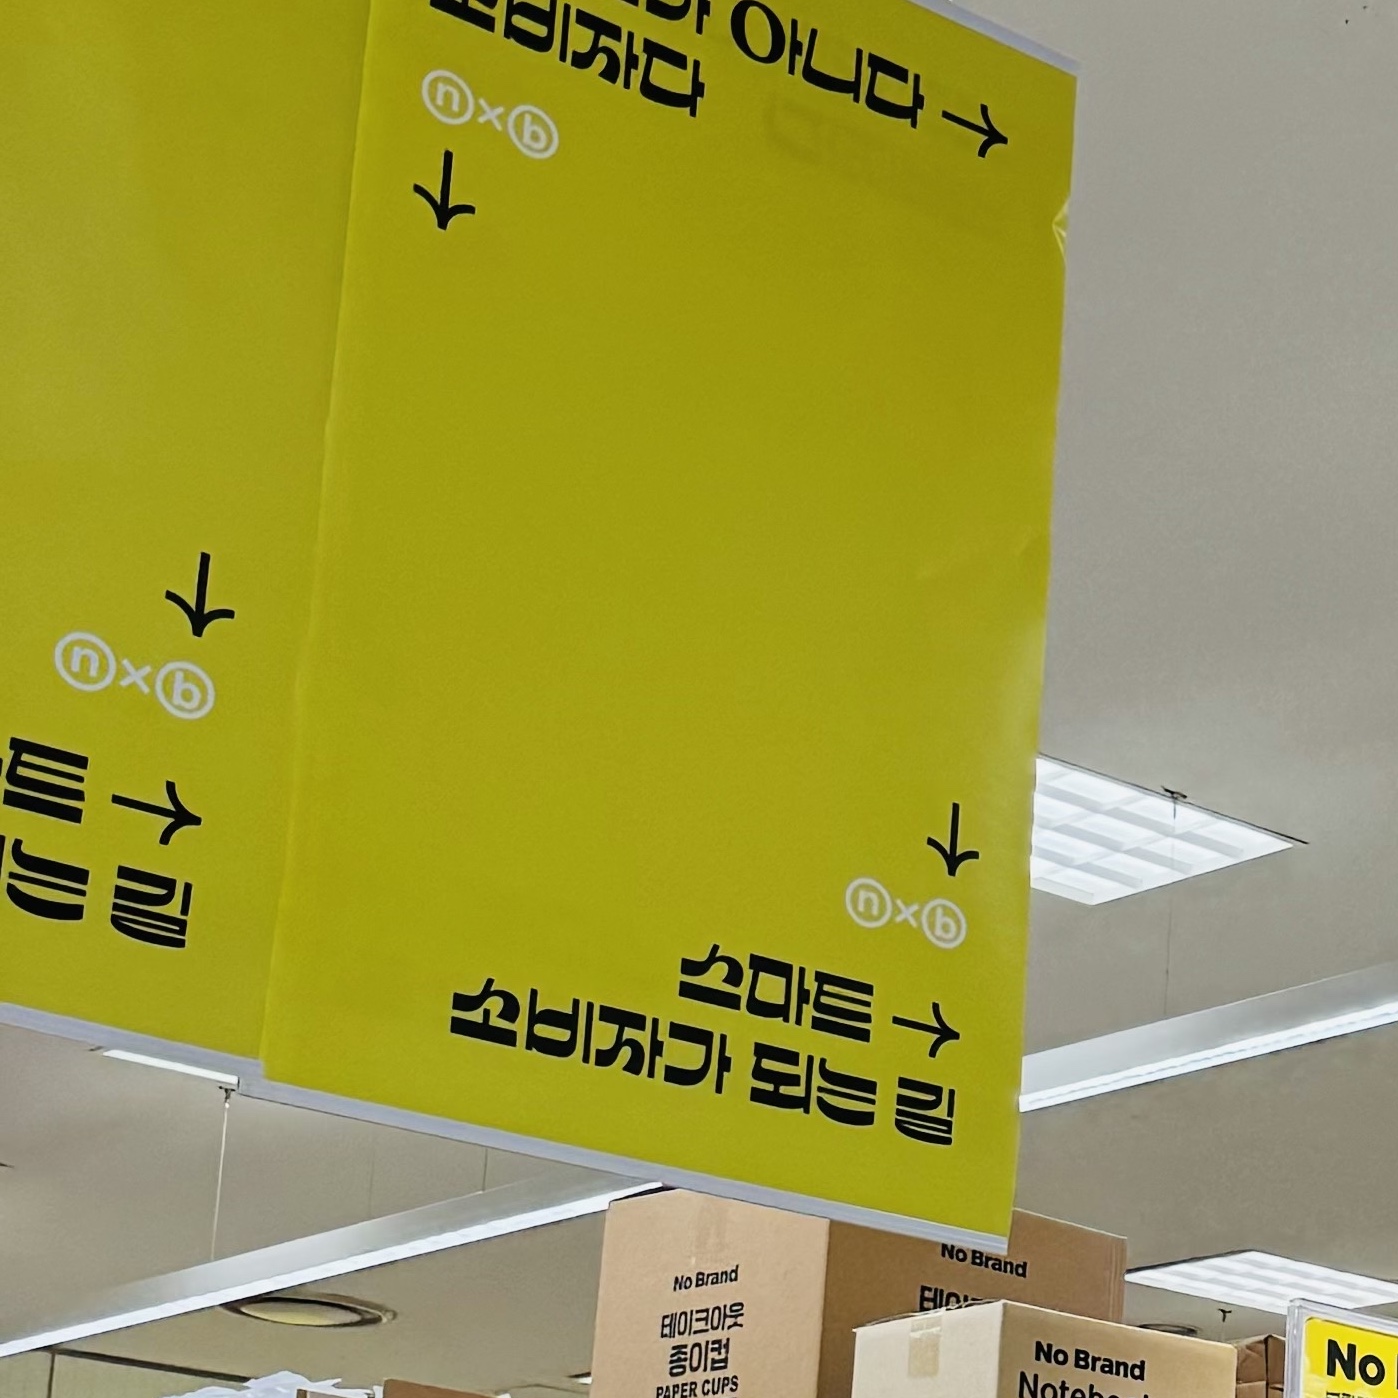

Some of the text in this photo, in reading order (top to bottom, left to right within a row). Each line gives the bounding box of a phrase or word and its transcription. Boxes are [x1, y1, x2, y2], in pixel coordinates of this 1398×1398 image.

[0, 838, 194, 949] 는 길
[679, 943, 876, 1043] 스마트
[451, 977, 957, 1147] 소비자가 되는 길
[660, 1301, 745, 1340] 테이크아웃
[667, 1338, 731, 1377] 종이컵
[1035, 1341, 1146, 1381] No Brand
[1326, 1338, 1386, 1386] No
[701, 1375, 739, 1397] CUPS
